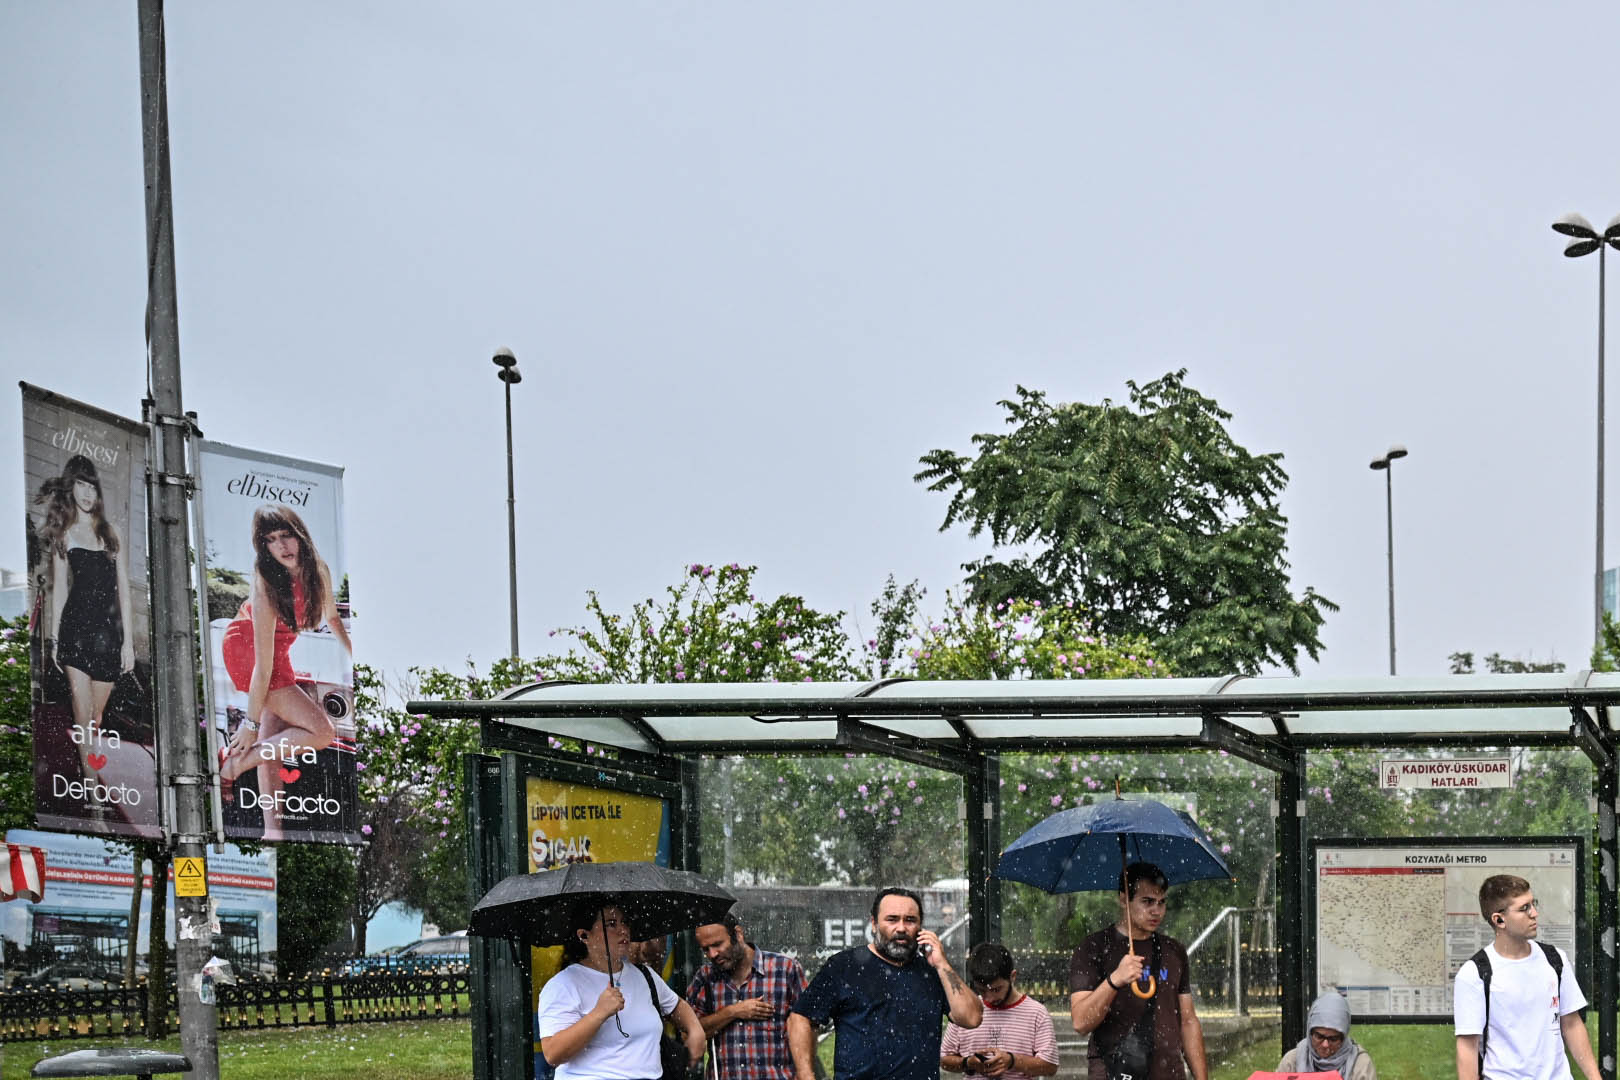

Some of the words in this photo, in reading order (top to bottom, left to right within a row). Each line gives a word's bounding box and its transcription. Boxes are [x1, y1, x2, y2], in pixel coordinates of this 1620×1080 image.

[53, 428, 119, 465] elbisesi
[227, 474, 311, 507] elbisesi
[71, 721, 121, 750] afra
[259, 738, 317, 765] afra
[1402, 762, 1506, 774] KADIKÖY-ÜSKÜDAR
[1431, 777, 1478, 787] HATLARI
[52, 774, 141, 806] DeFacto
[239, 787, 340, 816] DeFacto
[531, 801, 568, 820] LİPTON
[571, 805, 587, 820] ICE
[588, 805, 606, 819] TEA
[608, 801, 622, 819] İLE
[1405, 853, 1453, 864] KOZYATAĞI
[1456, 855, 1487, 864] METRO
